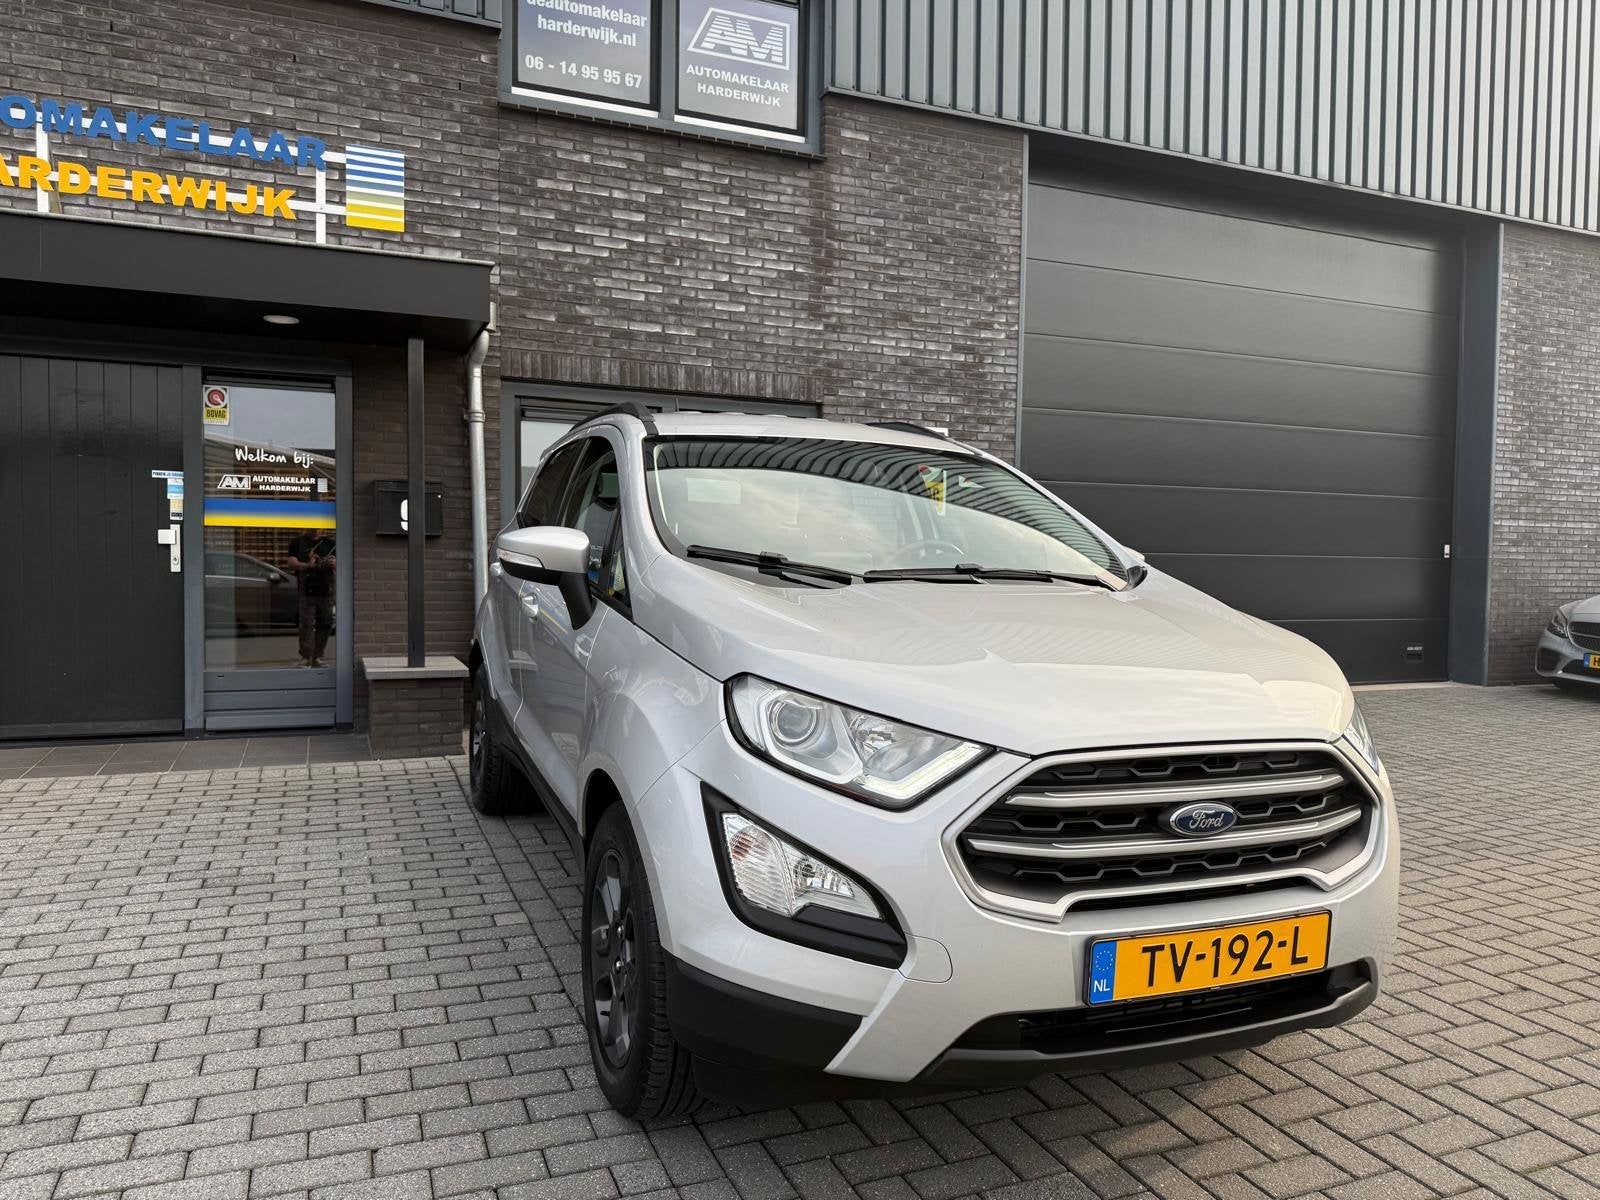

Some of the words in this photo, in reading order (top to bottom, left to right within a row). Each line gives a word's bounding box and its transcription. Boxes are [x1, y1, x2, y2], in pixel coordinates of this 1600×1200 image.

[537, 14, 637, 46] harderwijk.nl
[700, 15, 784, 63] AM
[525, 54, 544, 70] 06
[559, 61, 577, 76] 14
[581, 64, 599, 81] 95
[603, 68, 621, 85] 95
[625, 72, 643, 88] 67
[686, 64, 789, 93] AUTOMAKELAAR
[697, 82, 781, 107] HARDERWIJK
[0, 95, 327, 171] OMAKELAAR
[206, 409, 226, 419] BOVAG
[235, 445, 287, 463] Welkom
[293, 451, 314, 468] bij:
[222, 476, 249, 488] AM
[252, 475, 316, 484] AUTOMAKELAAR
[259, 484, 311, 492] HARDERWIJK
[1189, 809, 1225, 829] Ford
[1142, 926, 1309, 987] TV-192-L
[1093, 978, 1111, 992] NL
